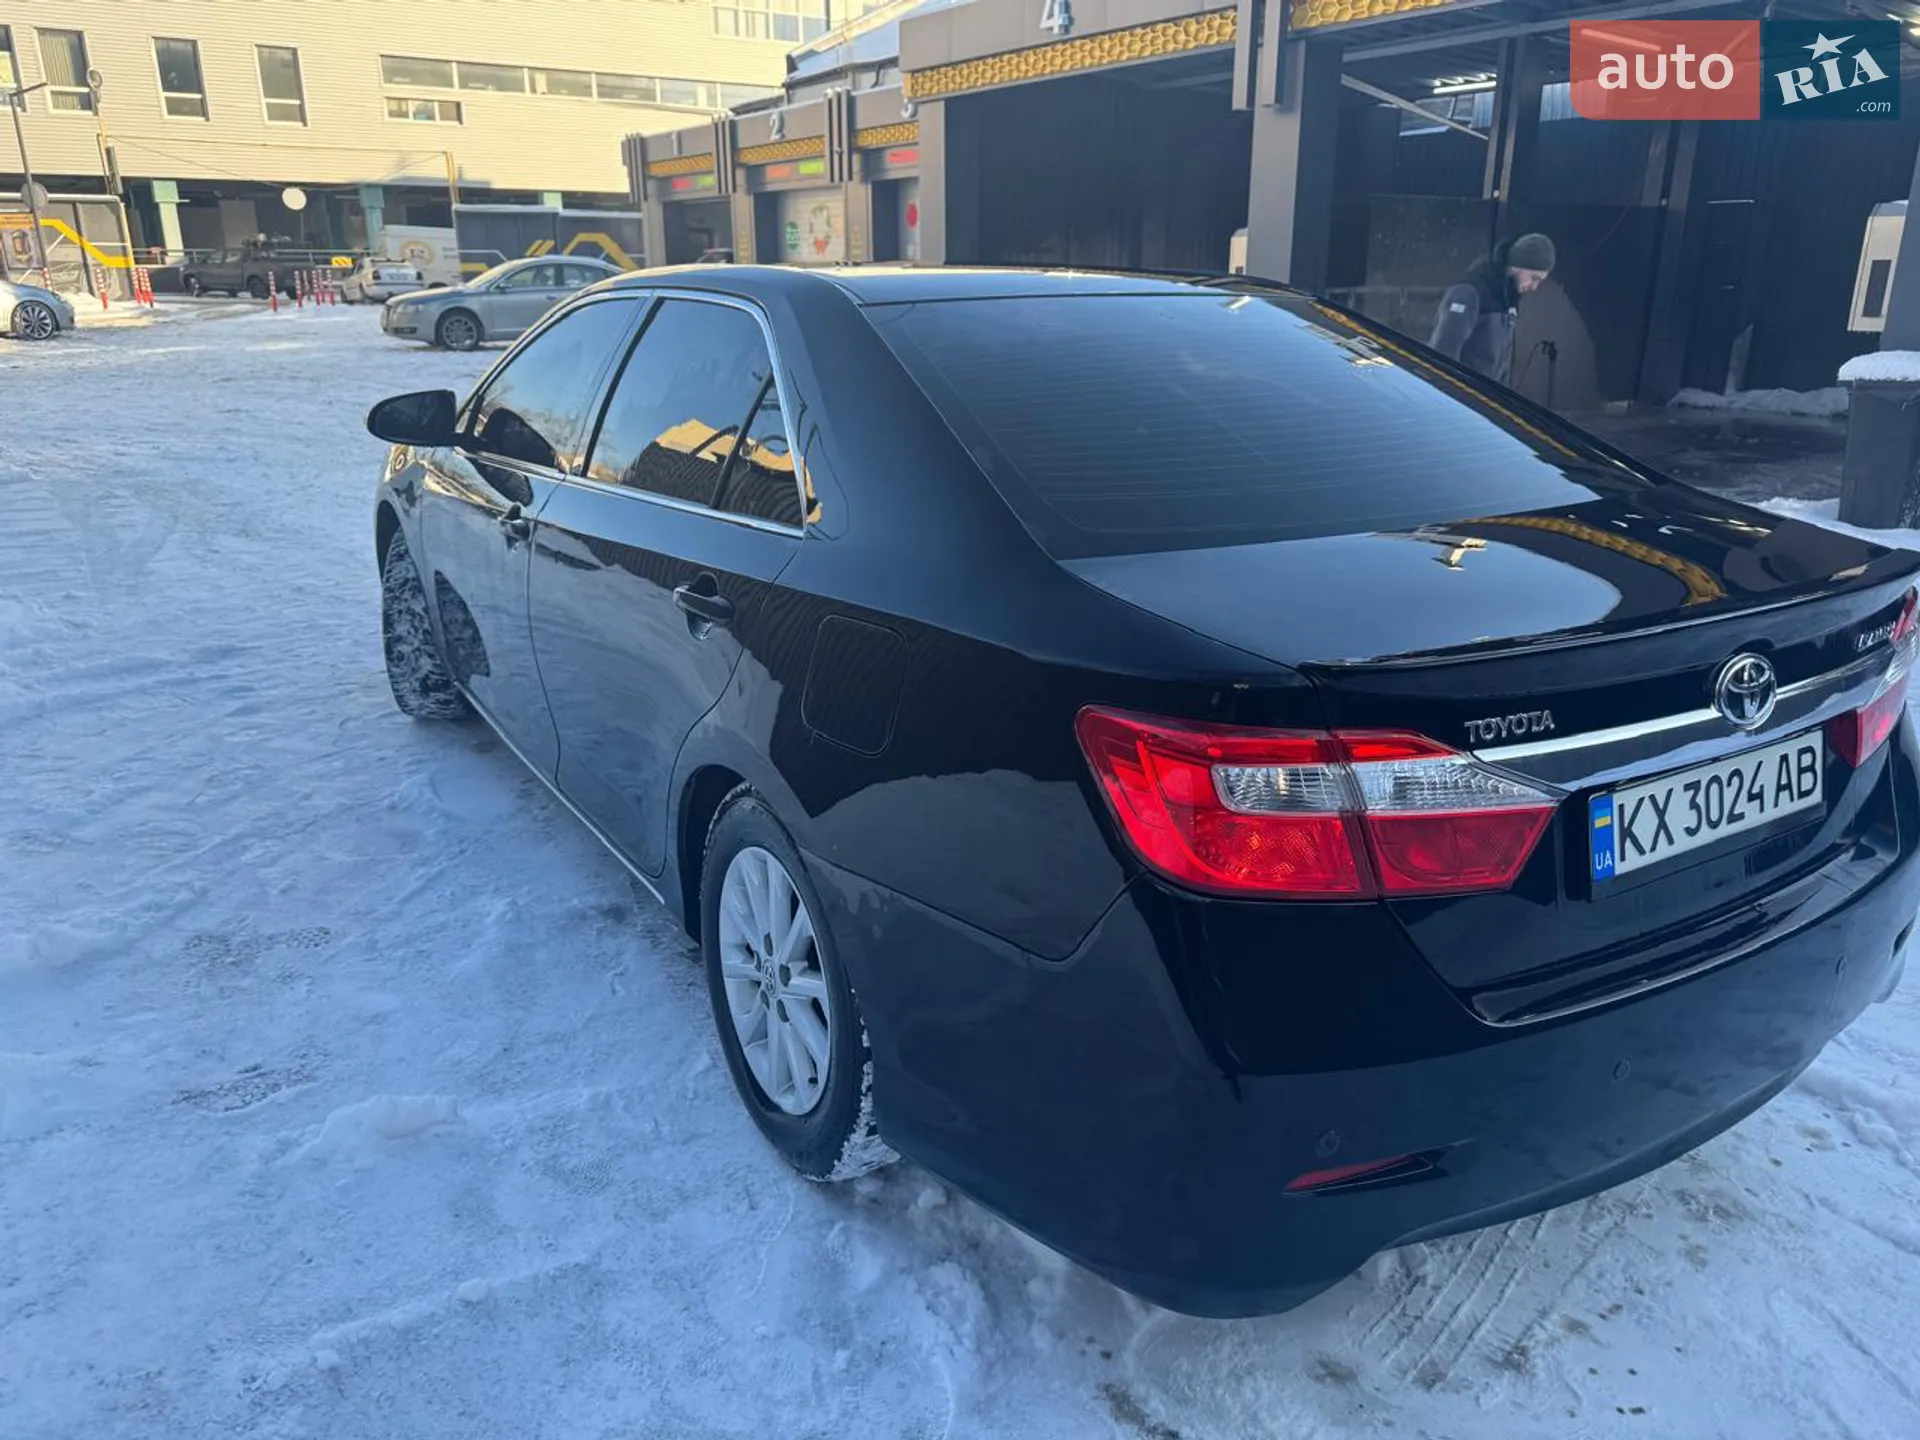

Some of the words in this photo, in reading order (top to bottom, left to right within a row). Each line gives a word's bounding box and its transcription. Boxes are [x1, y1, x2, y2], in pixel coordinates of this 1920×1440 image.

[1040, 0, 1072, 34] 4
[769, 111, 785, 140] 2
[1464, 709, 1555, 743] TOYOTA
[1618, 787, 1675, 862] KX
[1683, 760, 1766, 837] 3024
[1773, 745, 1819, 808] AB
[1595, 852, 1613, 870] UA
